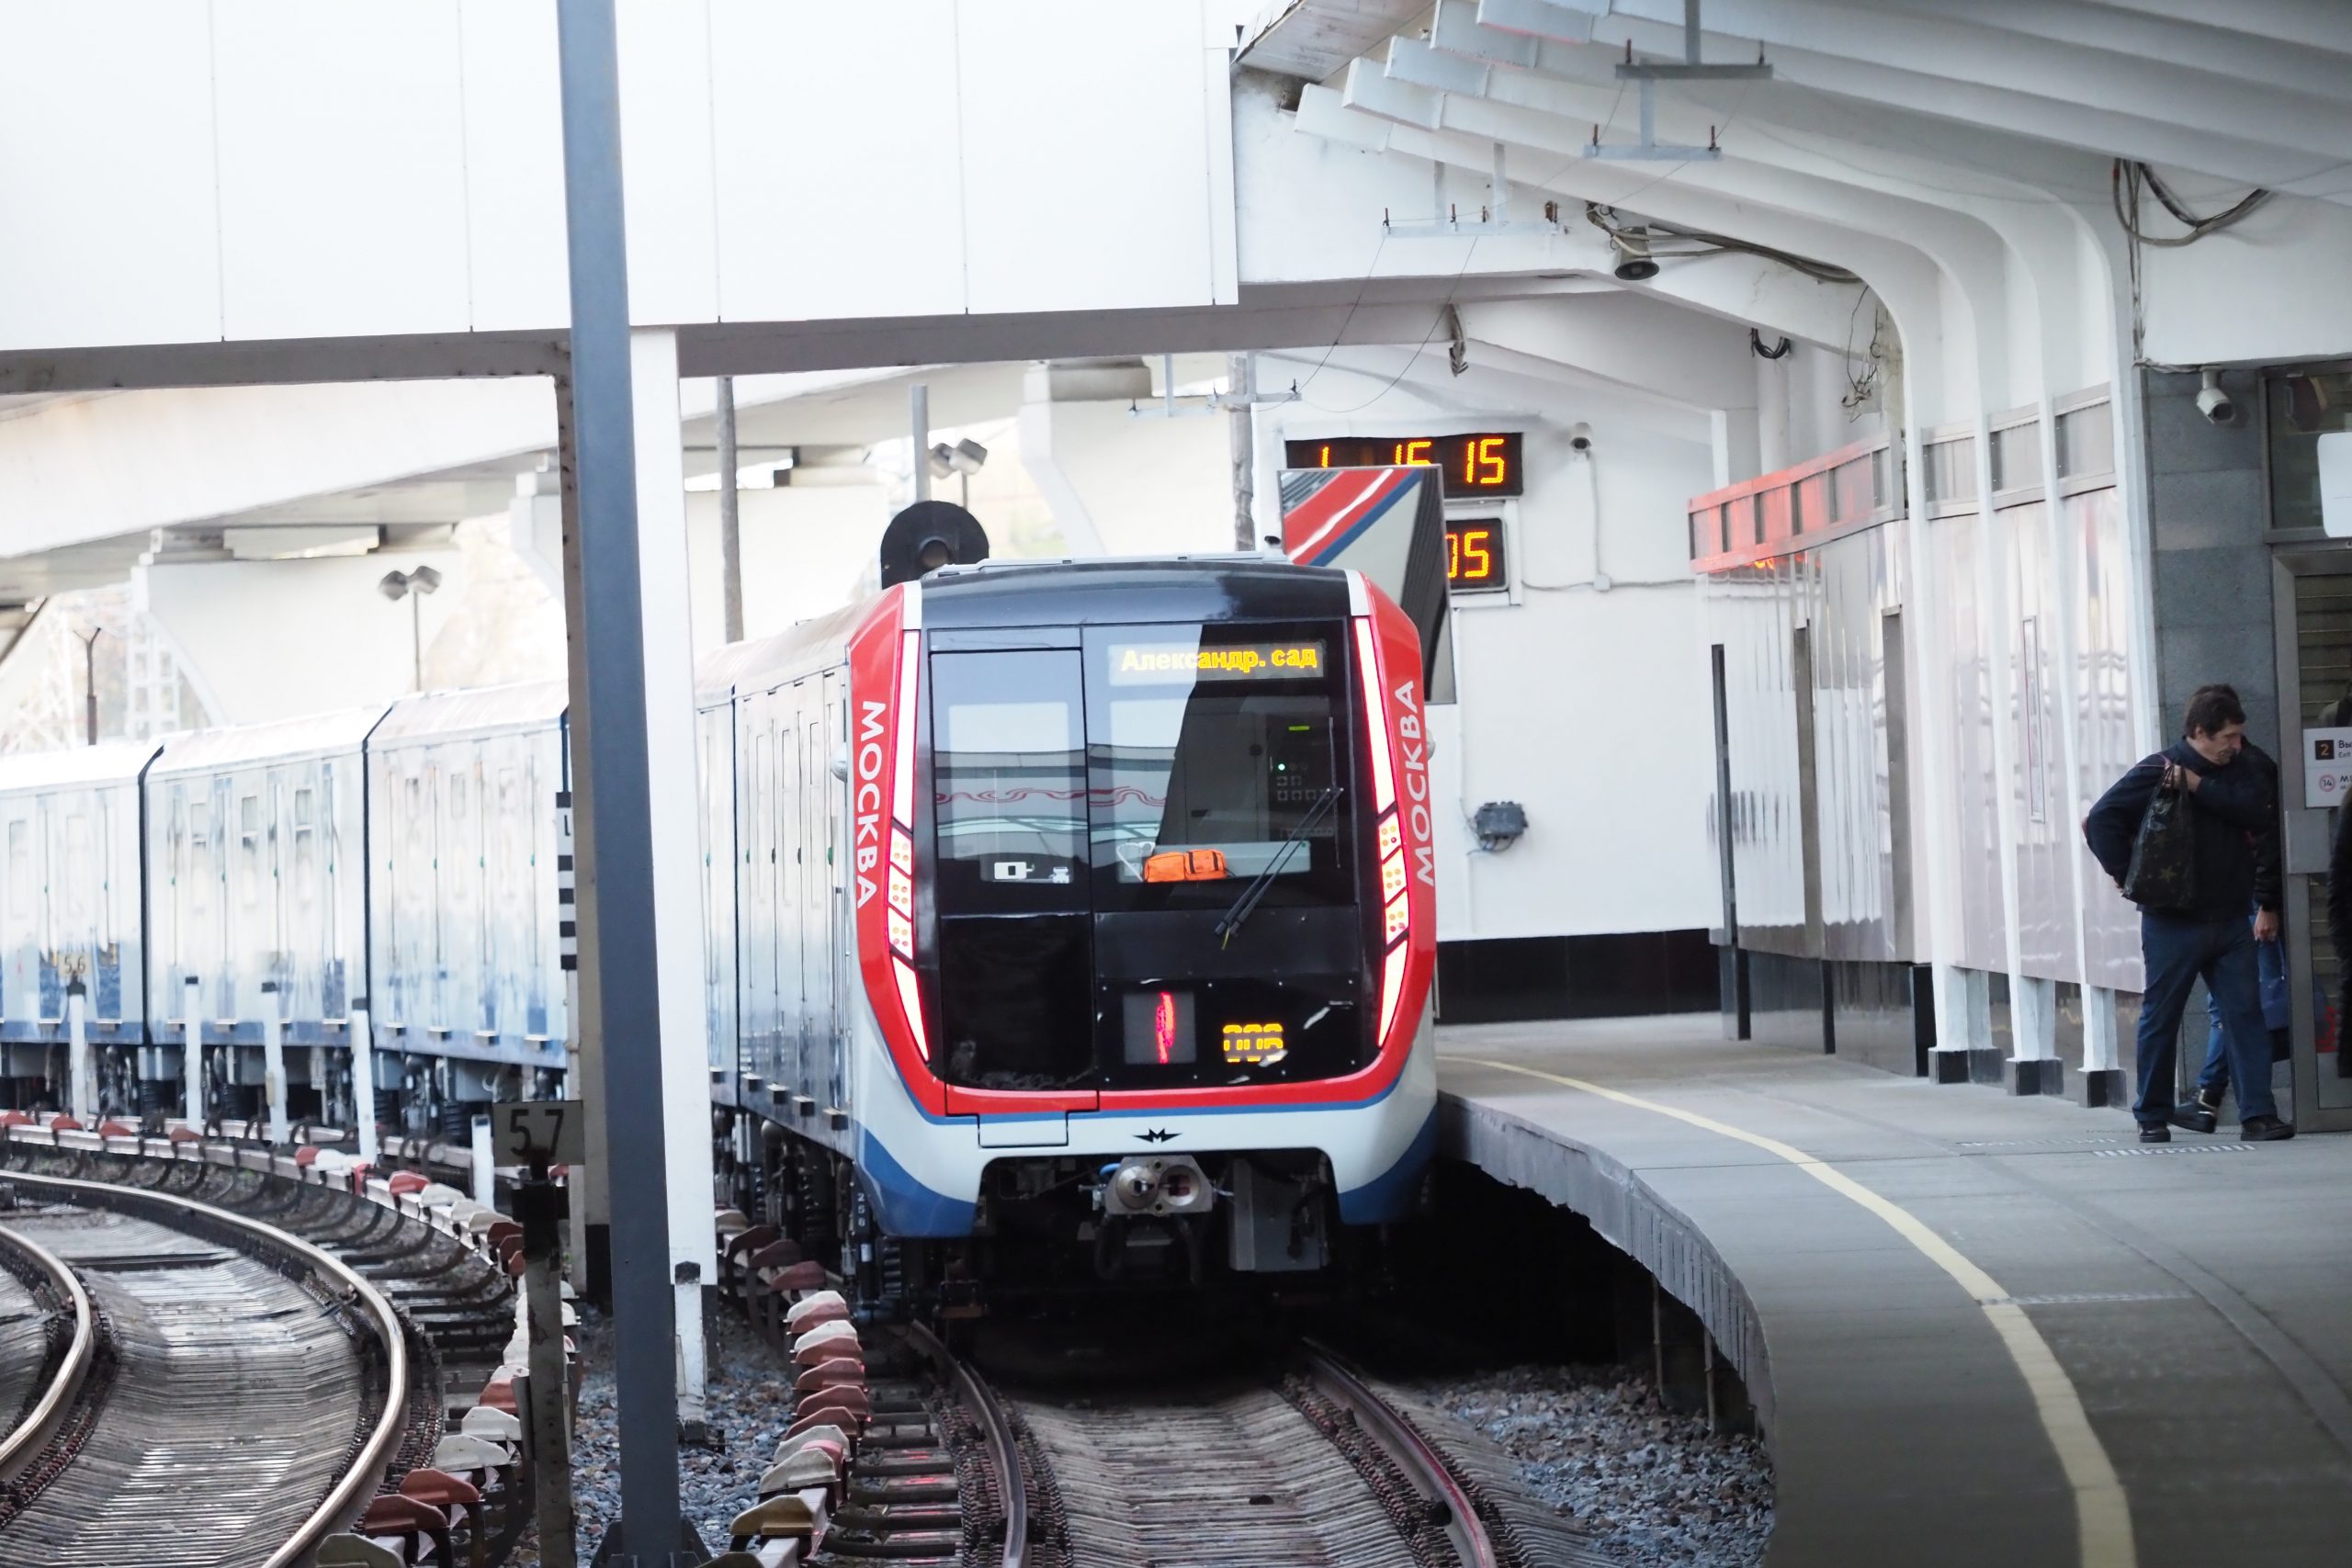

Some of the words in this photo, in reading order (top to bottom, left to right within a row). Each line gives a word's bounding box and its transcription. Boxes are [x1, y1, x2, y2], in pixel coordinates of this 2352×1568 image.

[1466, 437, 1505, 485] 15
[1120, 649, 1266, 673] Александр.
[1271, 649, 1318, 669] сад
[2320, 743, 2330, 756] 2
[856, 700, 887, 909] МОСКВА
[1394, 680, 1435, 887] МОСКВА
[64, 954, 86, 975] 56
[509, 1108, 565, 1157] 57
